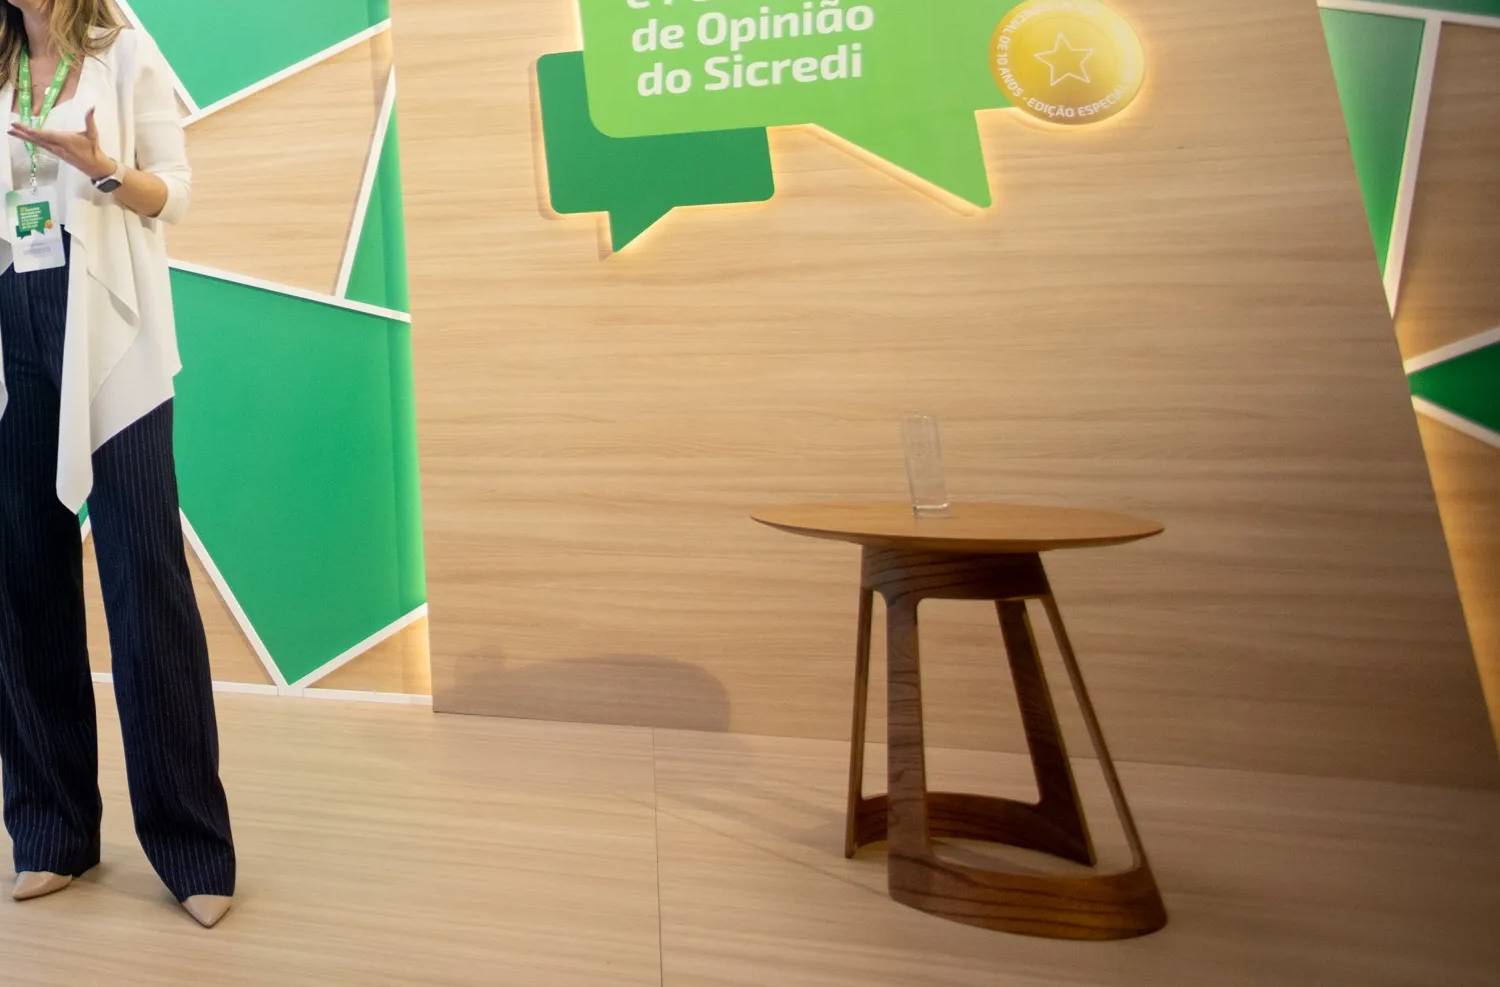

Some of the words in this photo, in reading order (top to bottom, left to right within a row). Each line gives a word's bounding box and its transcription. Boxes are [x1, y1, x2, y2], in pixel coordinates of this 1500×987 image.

[631, 18, 685, 53] de
[996, 34, 1012, 51] DE
[637, 62, 692, 97] do
[704, 42, 862, 91] Sicredi
[996, 53, 1008, 65] 10
[998, 67, 1024, 97] ANOS
[1027, 97, 1075, 118] EDIÇÃO
